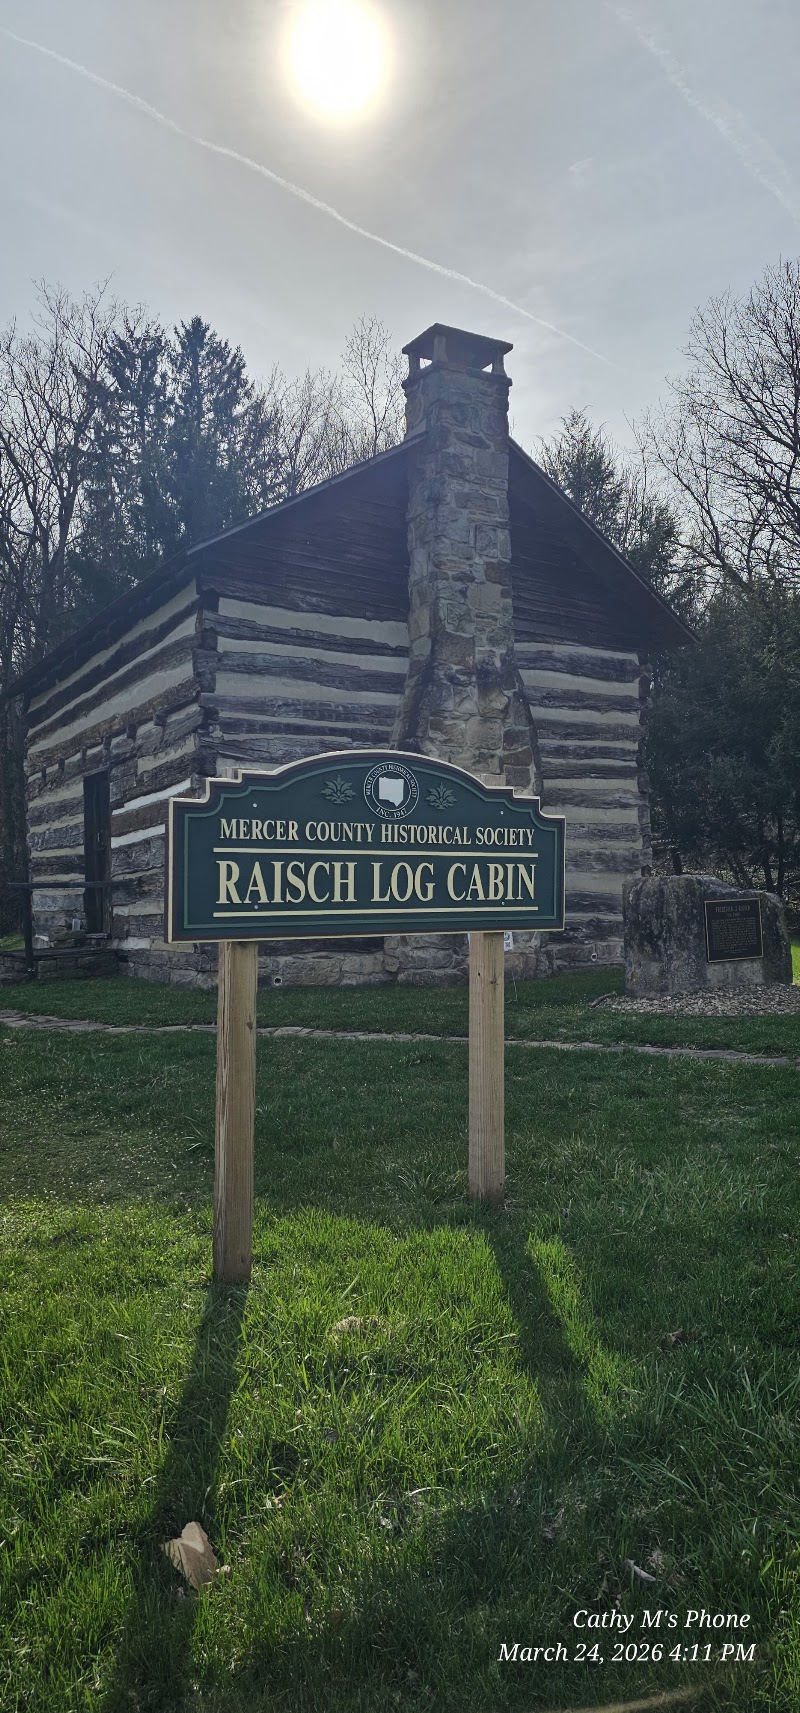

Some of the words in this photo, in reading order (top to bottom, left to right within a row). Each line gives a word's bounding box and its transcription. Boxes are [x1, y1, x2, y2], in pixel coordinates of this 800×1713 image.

[219, 818, 300, 841] MERCER
[305, 821, 375, 843] COUNTY
[380, 823, 472, 845] HISTORICAL
[475, 826, 535, 846] SOCIETY
[215, 860, 358, 904] RAISCH
[370, 862, 436, 902] LOG
[447, 862, 536, 901] CABIN
